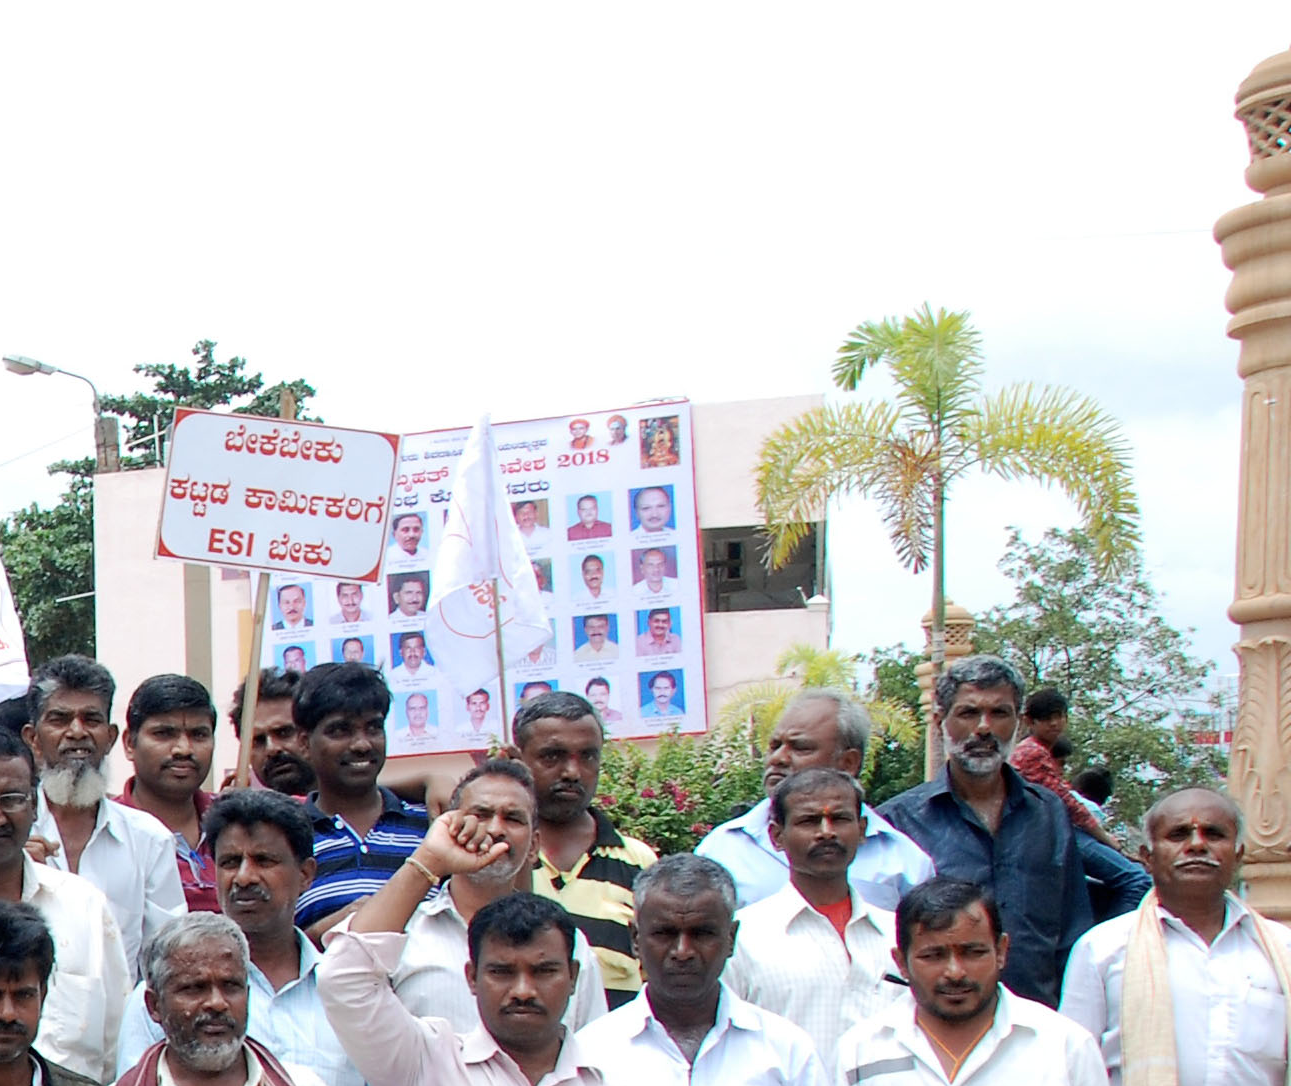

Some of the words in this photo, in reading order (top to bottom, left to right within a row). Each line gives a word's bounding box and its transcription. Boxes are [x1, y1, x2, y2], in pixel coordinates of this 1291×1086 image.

[224, 424, 342, 464] ಬೇಕೆಬೇಕು
[557, 448, 610, 468] 2018
[170, 479, 230, 518] ಕಟ್ಟಡ
[244, 487, 385, 523] ಕಾರ್ಮಿಕರಿಗೆ
[208, 527, 254, 558] ESI
[268, 534, 332, 567] ಬೇಕು
